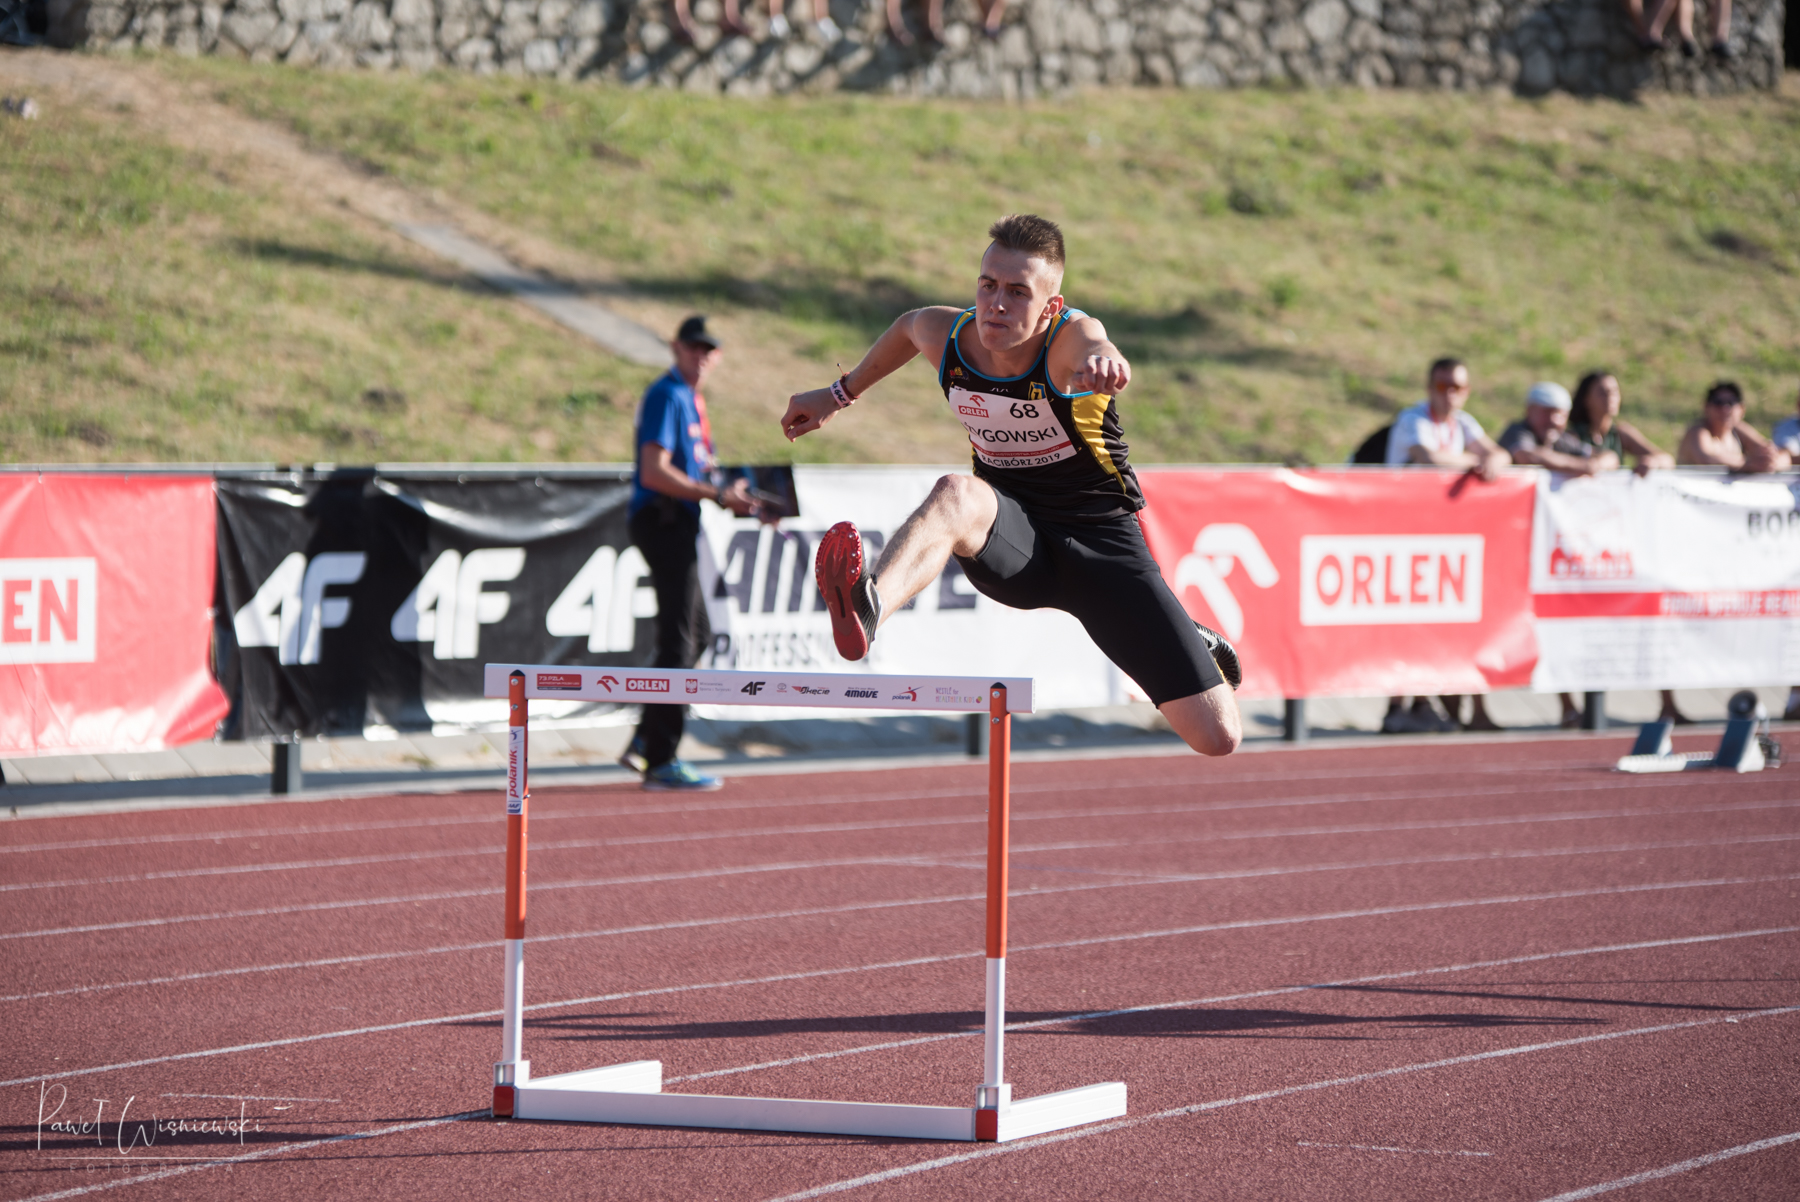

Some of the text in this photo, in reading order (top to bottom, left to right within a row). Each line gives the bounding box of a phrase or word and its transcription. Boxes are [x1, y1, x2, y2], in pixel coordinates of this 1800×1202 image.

[959, 406, 988, 418] ORLEN
[1009, 402, 1040, 419] 68
[1035, 452, 1061, 465] 2019
[1315, 553, 1467, 606] ORLEN
[389, 545, 528, 660] 4F
[545, 544, 660, 654] 4F
[233, 551, 369, 666] 4F
[627, 680, 668, 691] ORLEN
[740, 681, 766, 696] 4F
[844, 690, 879, 699] 4MOVE
[508, 749, 520, 799] polanik
